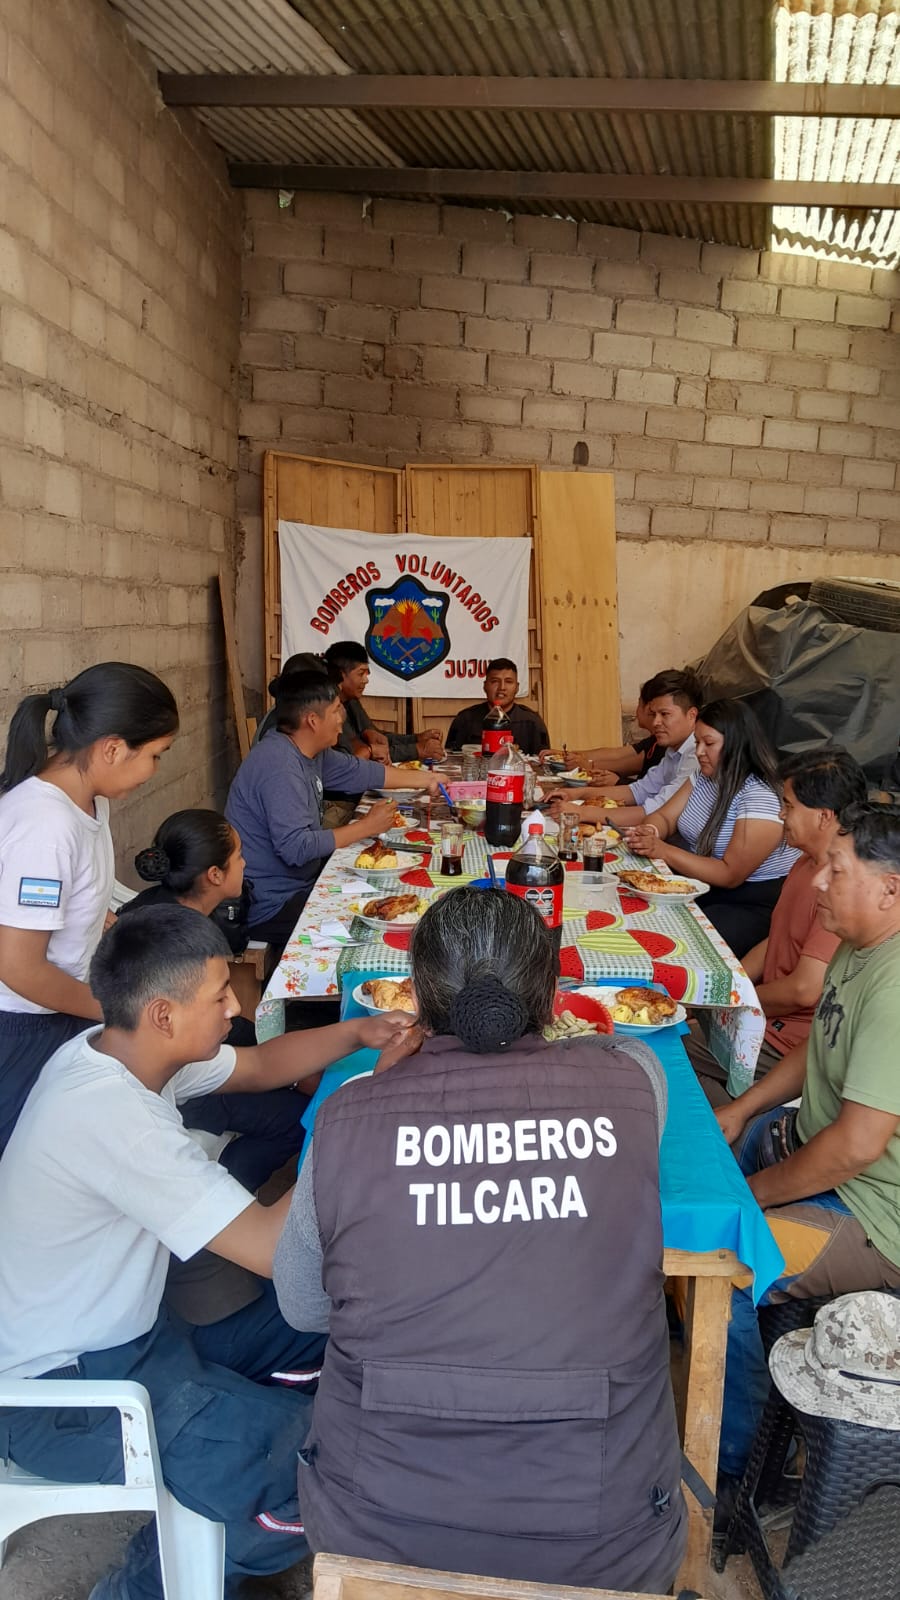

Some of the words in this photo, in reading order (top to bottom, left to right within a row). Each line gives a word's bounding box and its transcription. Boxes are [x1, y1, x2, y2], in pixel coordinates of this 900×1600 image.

[310, 561, 381, 635] BOMBEROS
[395, 554, 500, 632] VOLUNTARIOS
[444, 658, 492, 678] JUJU
[395, 1117, 617, 1167] BOMBEROS
[409, 1175, 588, 1226] TILCARA
